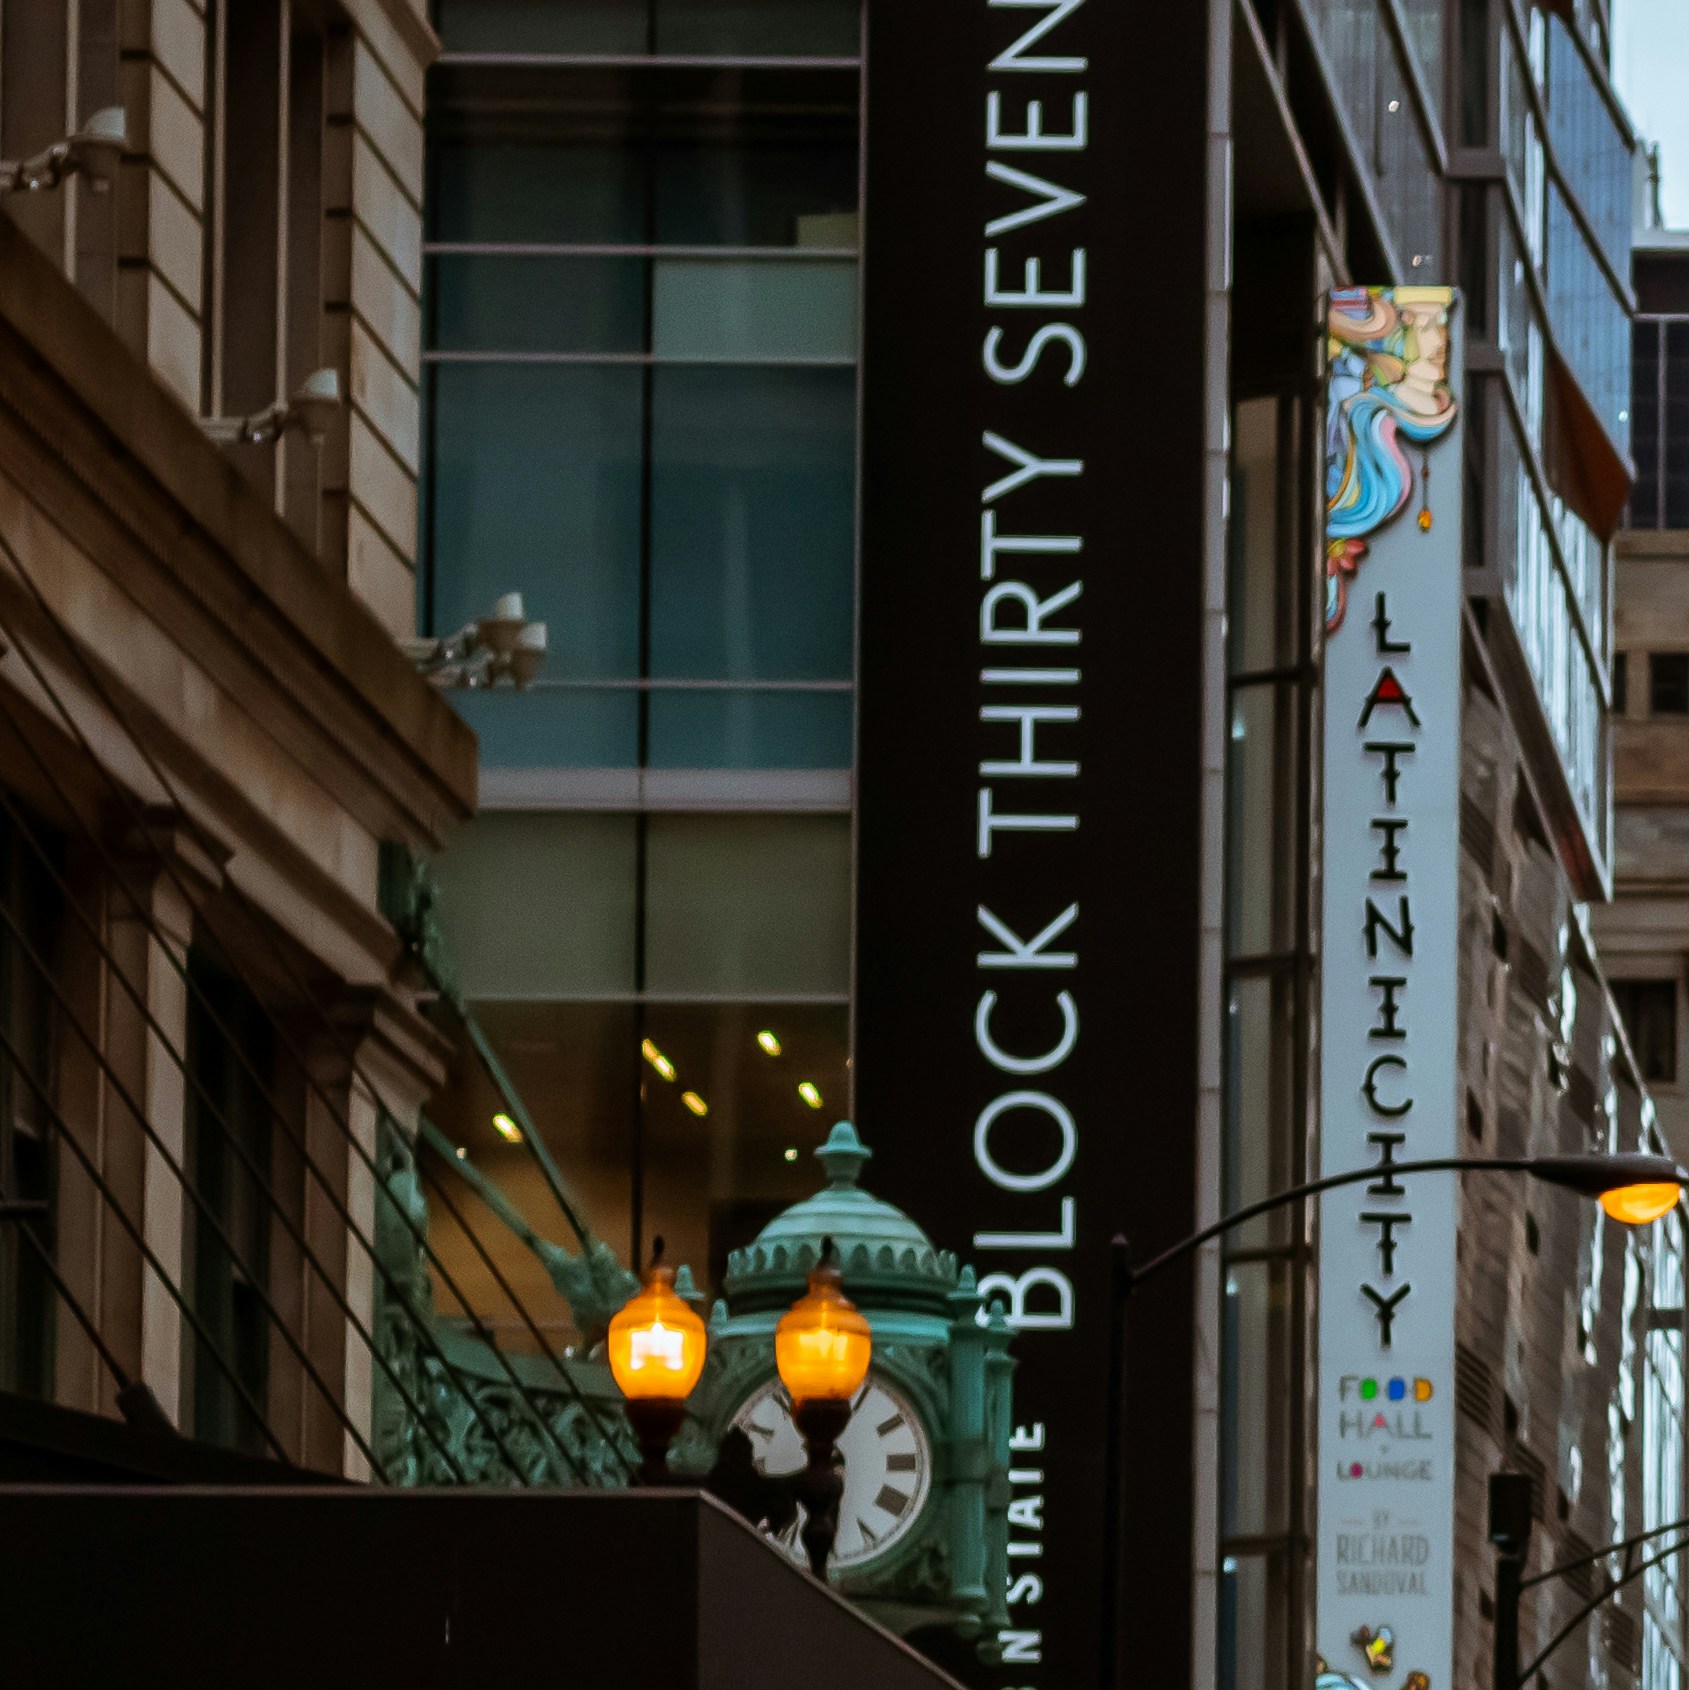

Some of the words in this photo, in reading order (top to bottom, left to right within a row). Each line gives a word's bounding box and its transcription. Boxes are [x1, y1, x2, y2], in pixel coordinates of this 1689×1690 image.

[982, 0, 1089, 387] SEVEN
[977, 430, 1083, 858] THIRTY
[1358, 591, 1421, 1346] LATINICITY
[973, 901, 1080, 1331] BLOCK
[1336, 1460, 1433, 1481] LOUNGE
[1340, 1377, 1433, 1401] FOOD
[1340, 1411, 1433, 1438] HALL
[1005, 1421, 1046, 1605] STATE
[1336, 1534, 1430, 1564] RICHARD
